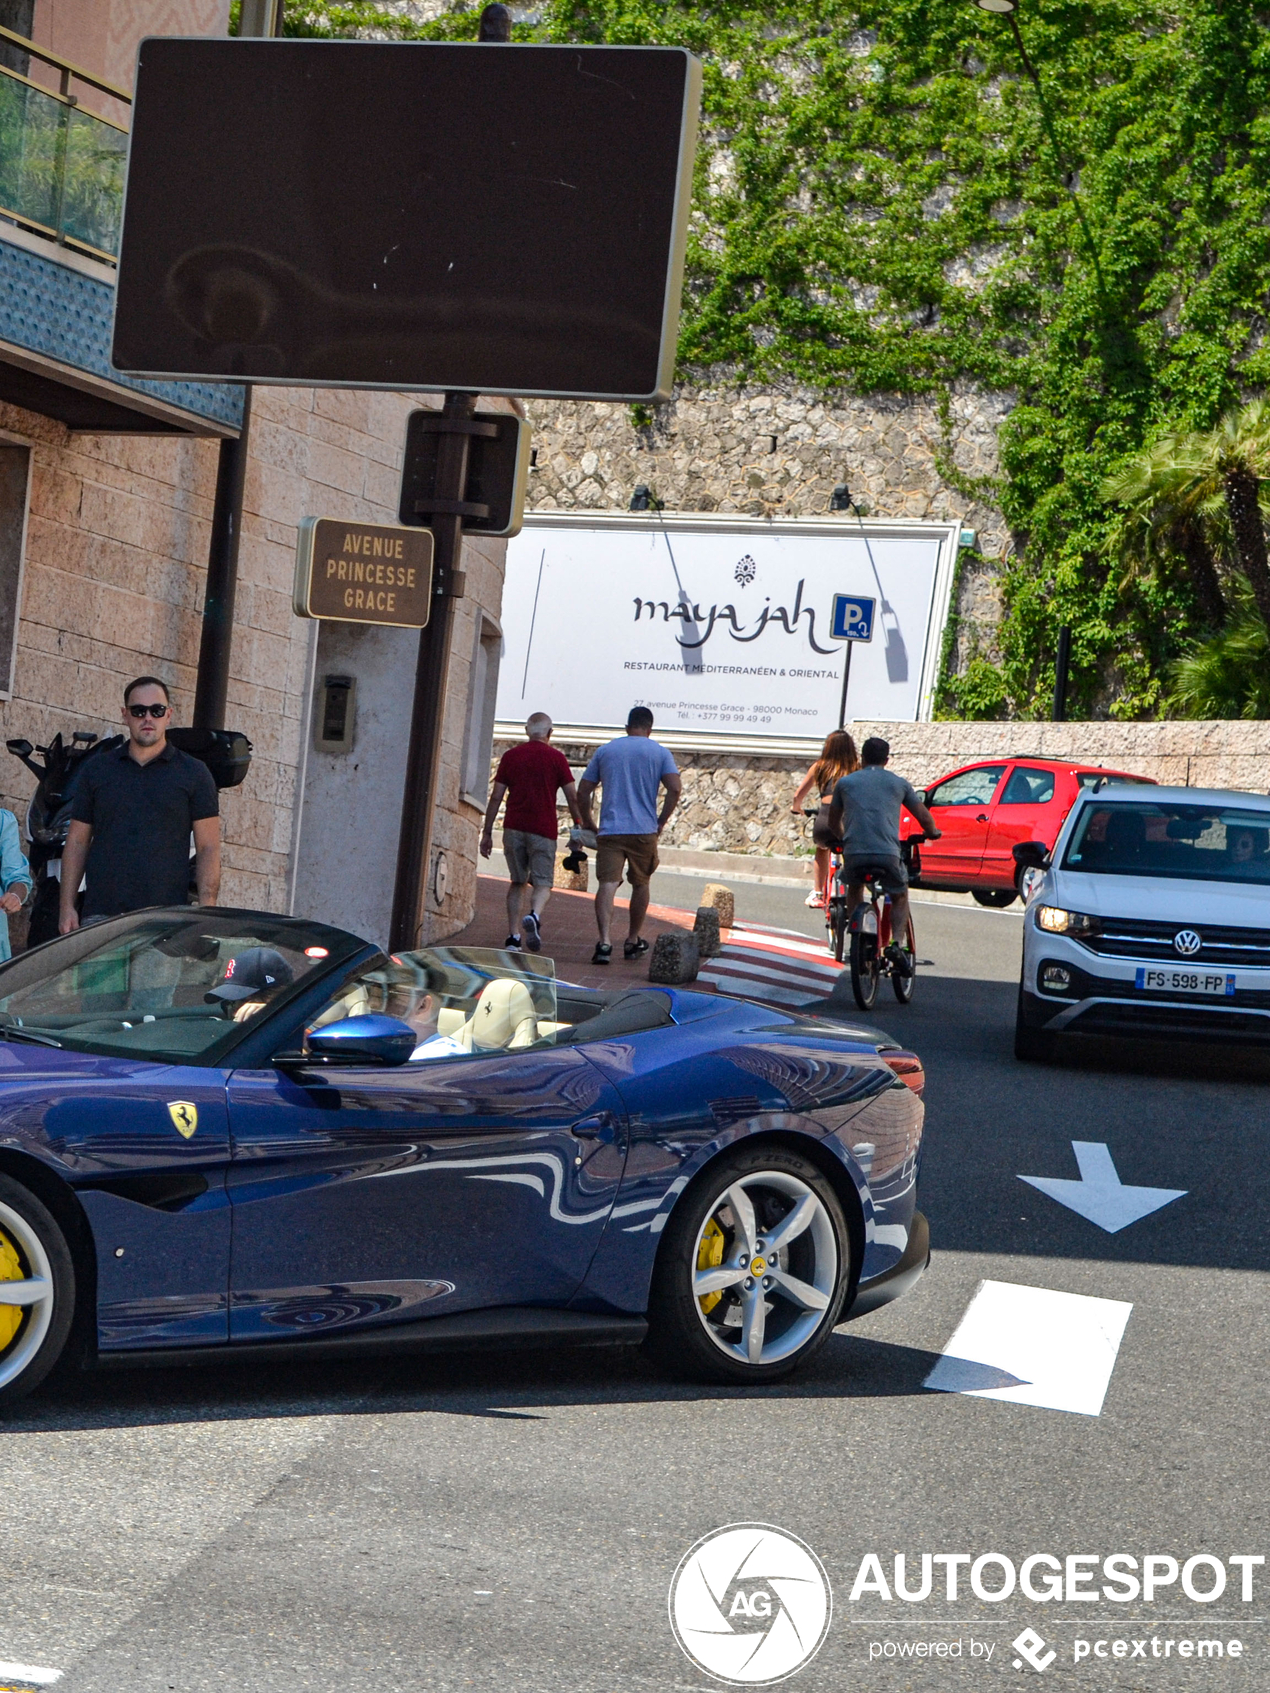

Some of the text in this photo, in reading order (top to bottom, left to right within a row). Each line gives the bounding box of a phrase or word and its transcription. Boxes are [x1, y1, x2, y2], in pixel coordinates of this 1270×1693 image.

[343, 533, 404, 559] AVENUE
[326, 559, 416, 588] PRINCESSE
[344, 588, 396, 612] GRACE
[843, 603, 863, 631] P
[623, 661, 839, 679] RESTAURANT MÉDITERRANÉEN & ORIENTAL
[646, 701, 677, 709] avenue
[679, 701, 718, 711] Princesse
[720, 703, 745, 713] Grace
[753, 704, 782, 715] 98000
[784, 707, 818, 716] Monaco
[697, 712, 717, 721] +377
[719, 713, 731, 722] 99
[733, 714, 745, 723] 99
[746, 715, 758, 723] 49
[760, 715, 772, 724] 49
